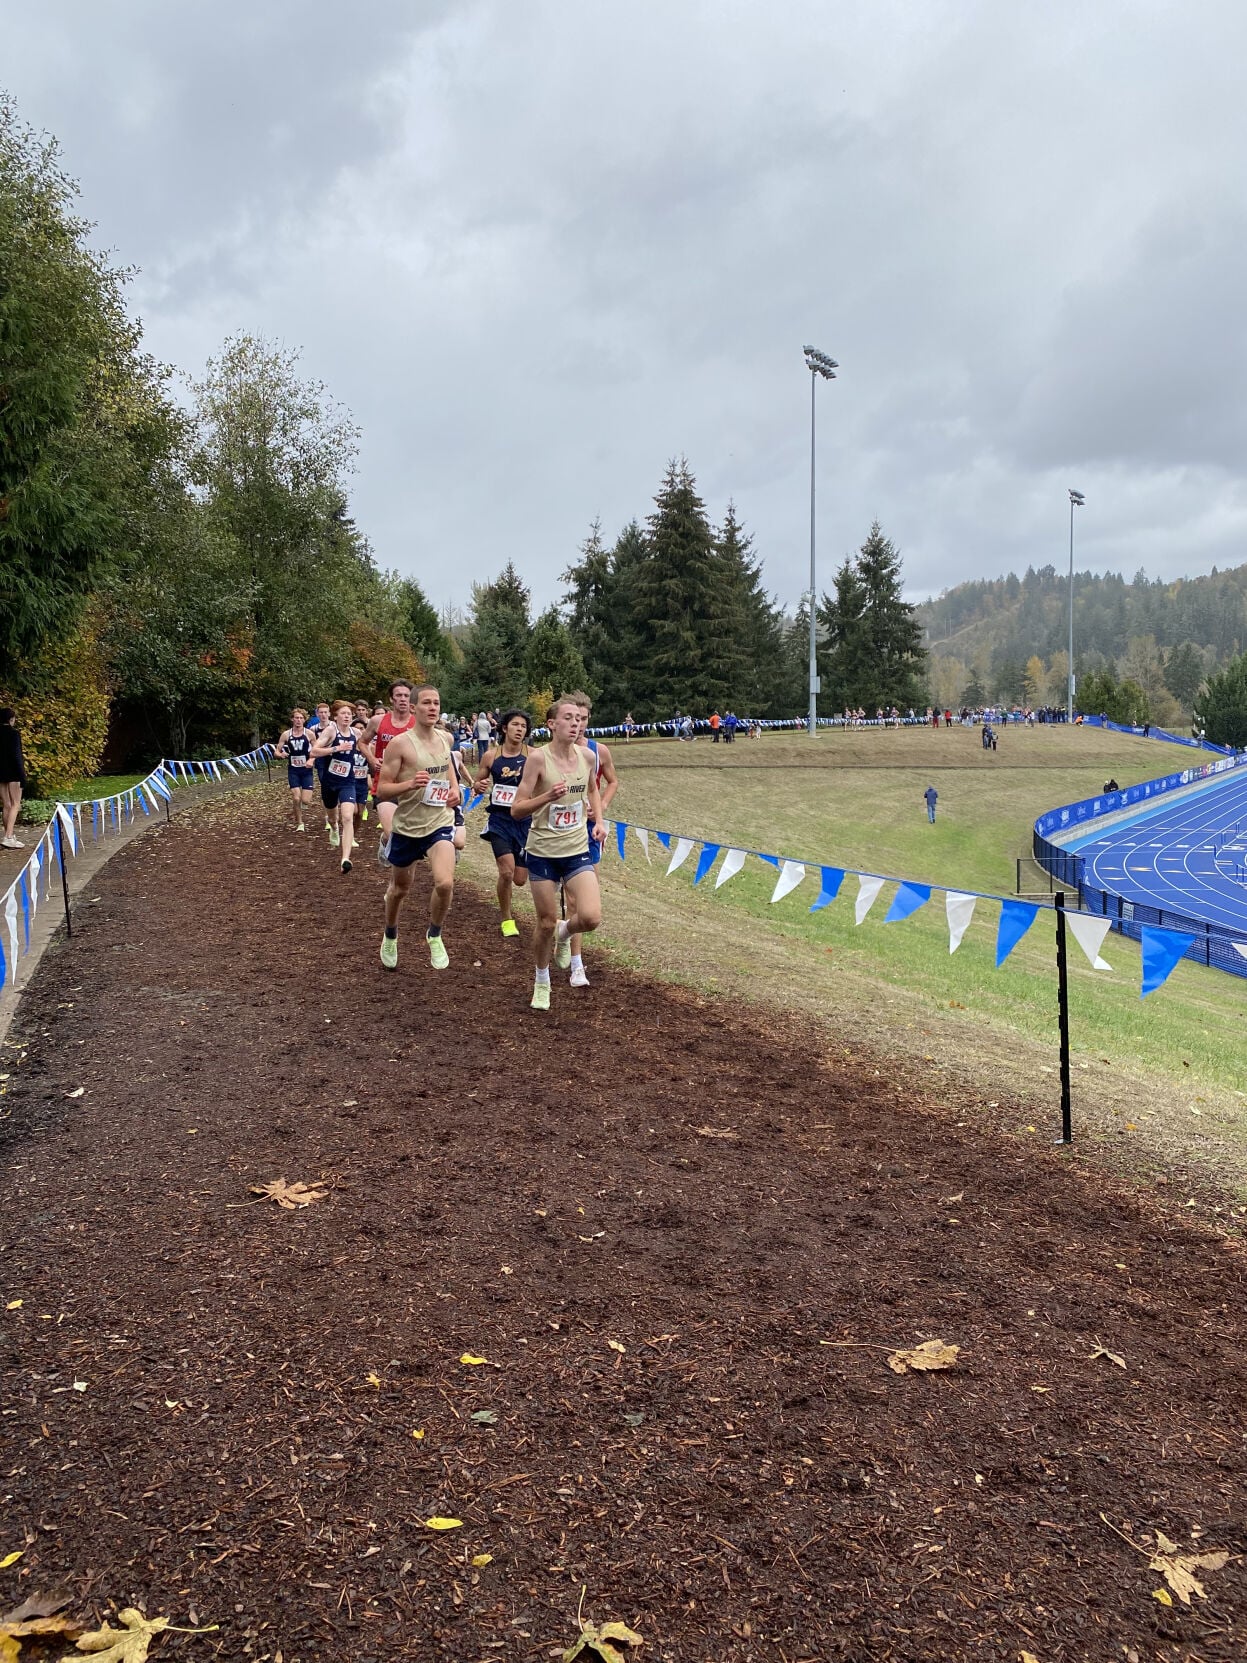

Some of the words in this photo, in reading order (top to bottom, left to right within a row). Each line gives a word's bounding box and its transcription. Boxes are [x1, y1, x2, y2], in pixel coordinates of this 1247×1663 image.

[290, 739, 305, 751] W
[353, 753, 366, 767] W
[333, 763, 348, 774] 830
[430, 787, 449, 801] 792
[570, 785, 586, 793] RIVER
[495, 790, 514, 802] 747
[555, 811, 578, 826] 791
